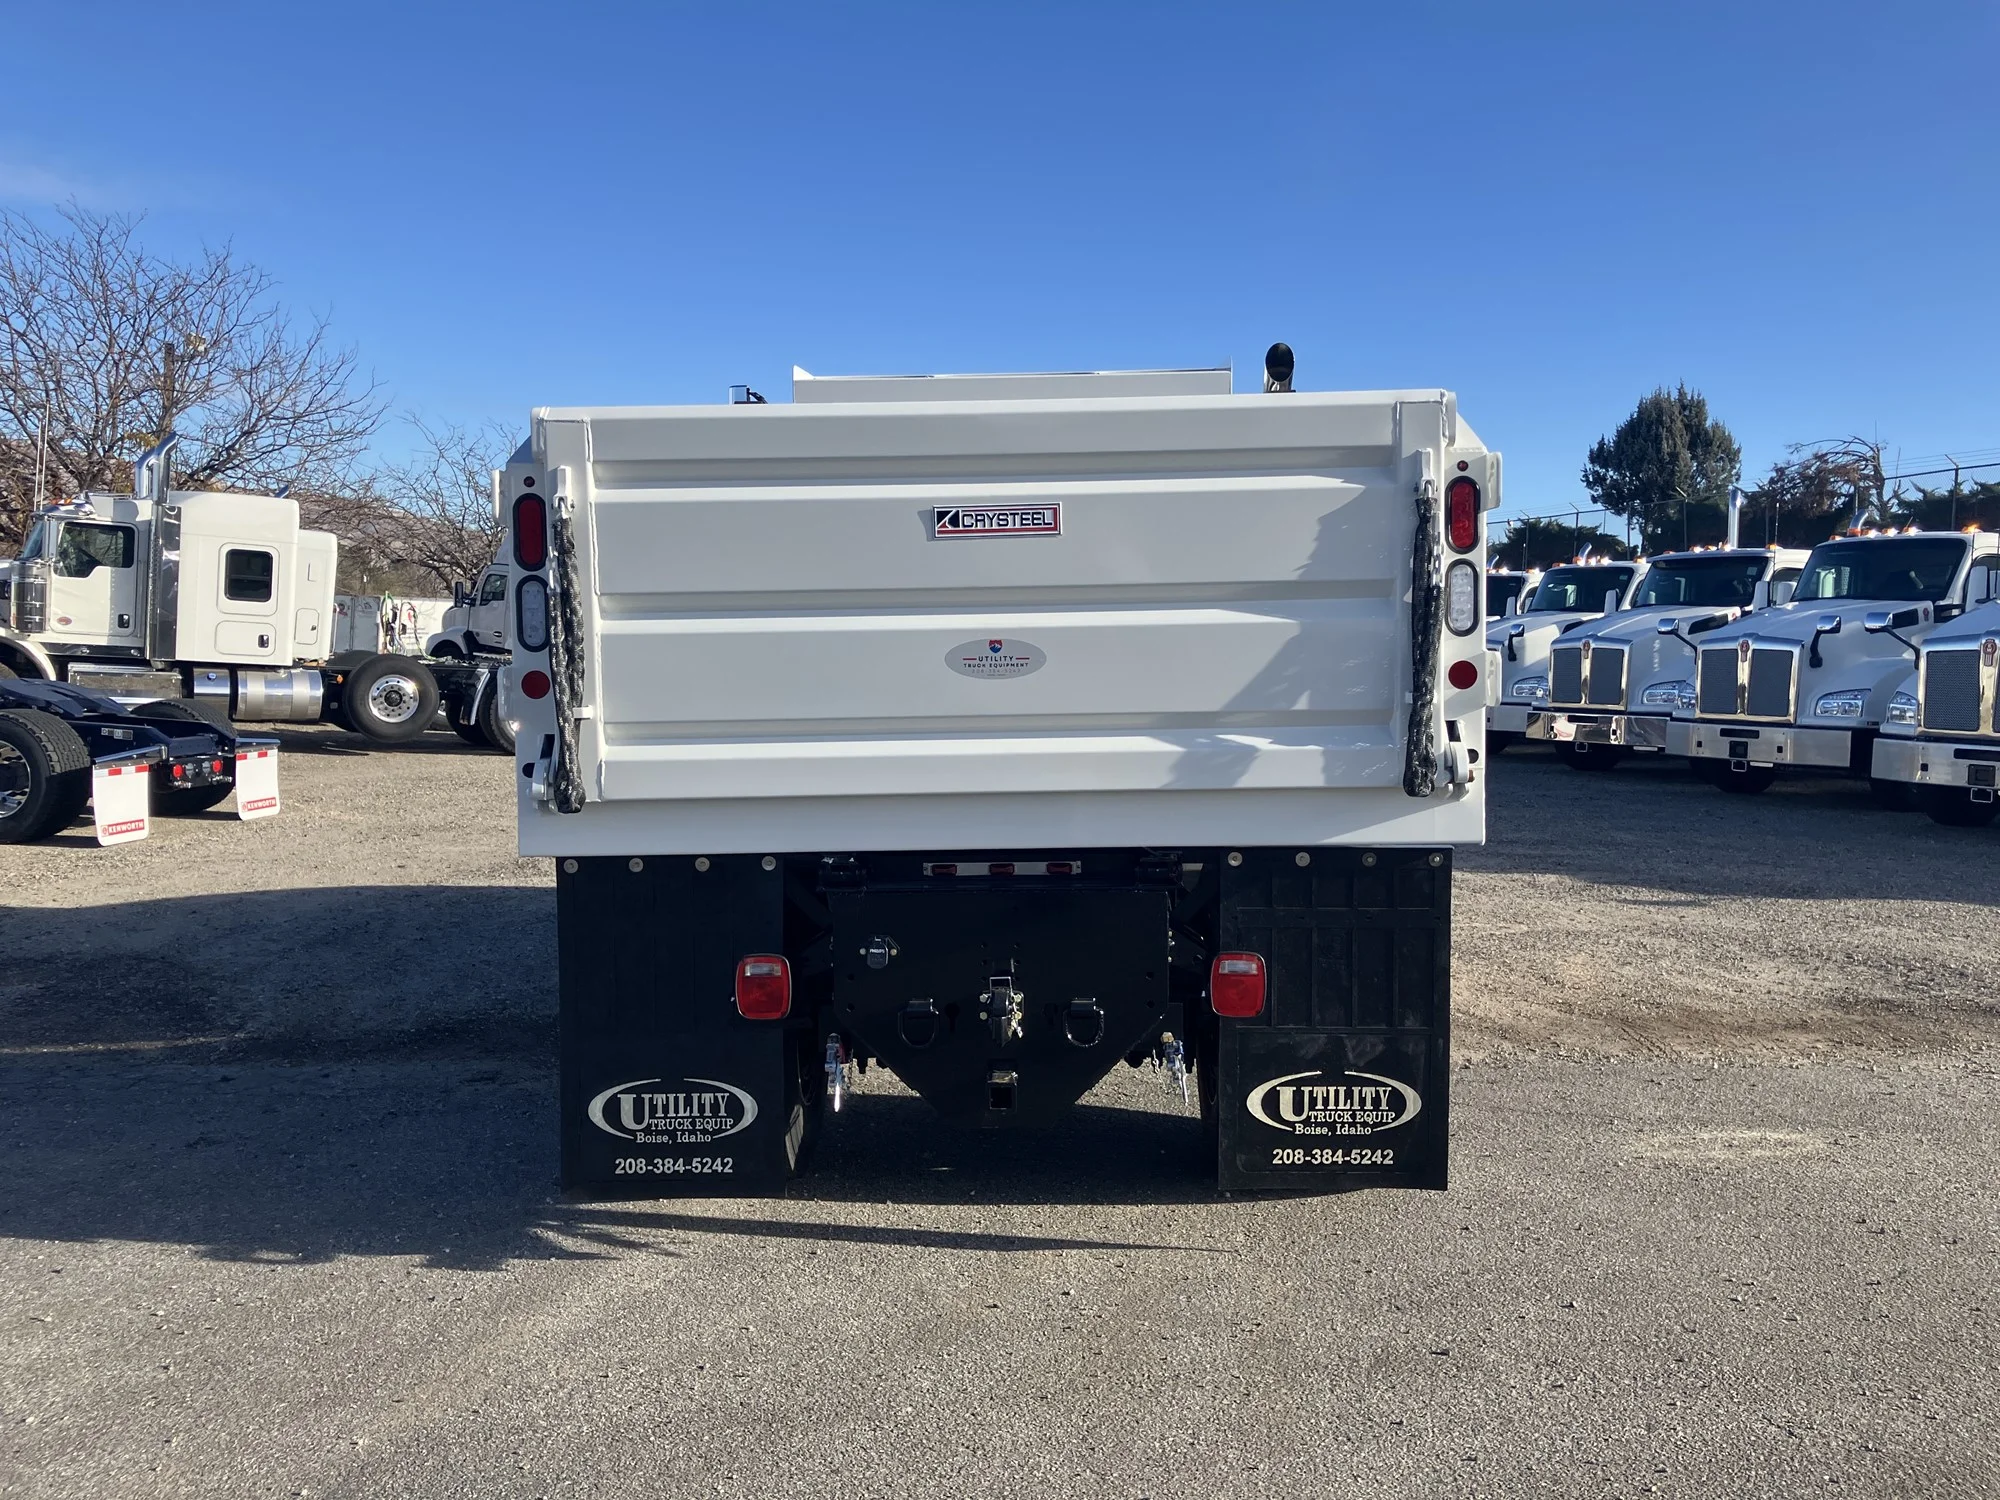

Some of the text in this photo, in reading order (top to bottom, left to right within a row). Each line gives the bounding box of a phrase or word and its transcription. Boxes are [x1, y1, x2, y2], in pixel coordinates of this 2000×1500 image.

[962, 511, 1053, 528] CRYSTEEL
[247, 798, 276, 810] KENWORTH
[108, 820, 144, 833] KENWORTH
[617, 1092, 730, 1130] UTILITY
[1276, 1086, 1392, 1122] UTILITY
[649, 1117, 734, 1132] TRUCK EQUIP
[1308, 1111, 1396, 1124] TRUCK EQUIP
[1295, 1123, 1372, 1136] Boise, Idaho
[635, 1131, 712, 1144] Boise, Idaho
[1272, 1148, 1394, 1165] 208-384-5242
[614, 1157, 733, 1174] 208-384-5242
